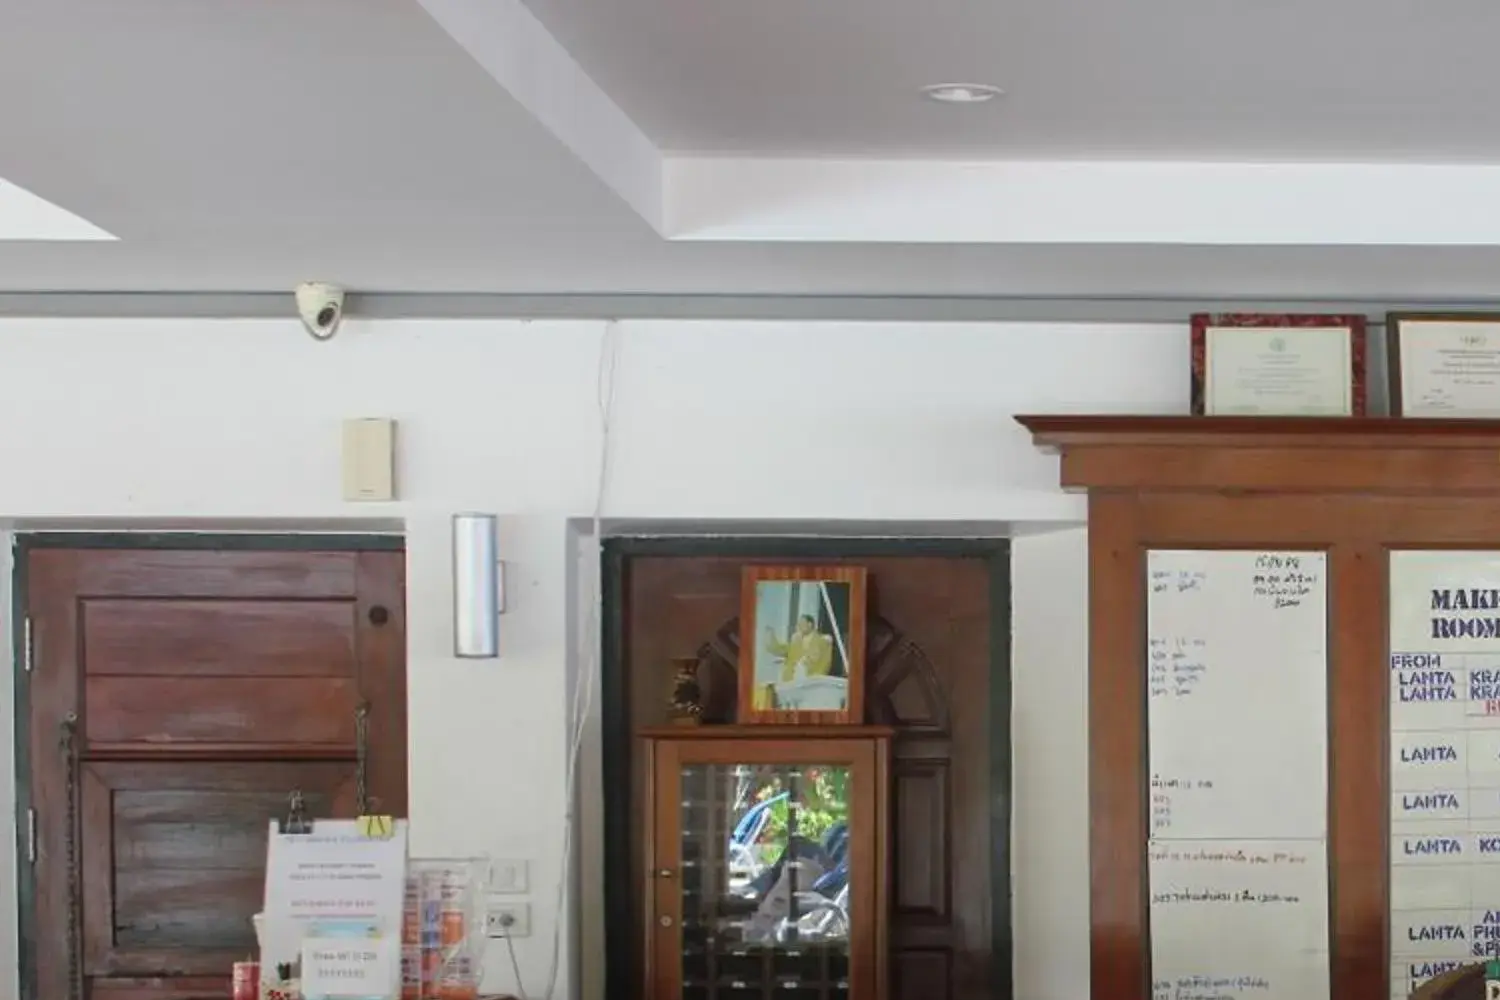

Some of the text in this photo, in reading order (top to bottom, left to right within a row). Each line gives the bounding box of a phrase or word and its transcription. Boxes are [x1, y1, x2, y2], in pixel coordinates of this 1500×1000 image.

[1391, 652, 1442, 670] FROM
[1399, 671, 1456, 687] LANTA
[1399, 686, 1456, 702] LANTA
[1400, 746, 1457, 763] LANTA
[1402, 793, 1460, 811] LANTA
[1404, 838, 1462, 855] LANTA
[1408, 925, 1465, 941] LANTA
